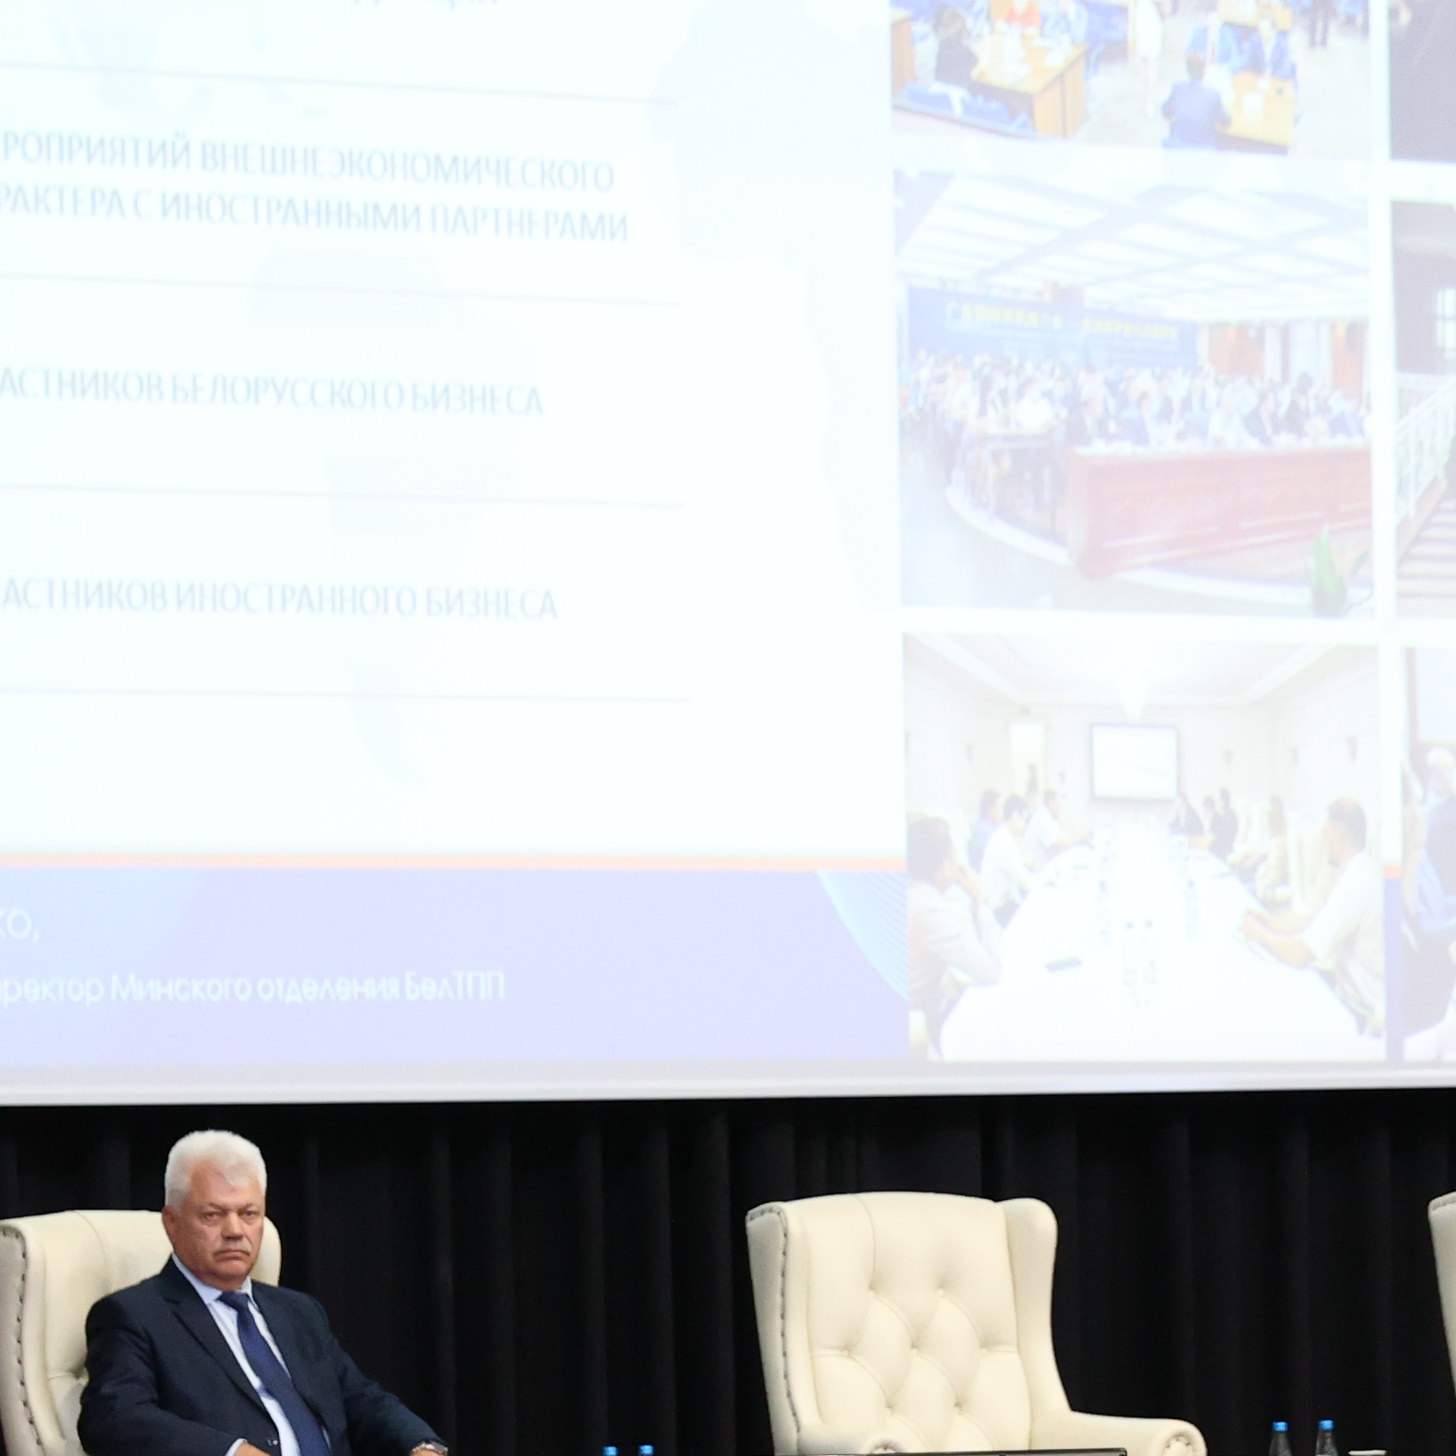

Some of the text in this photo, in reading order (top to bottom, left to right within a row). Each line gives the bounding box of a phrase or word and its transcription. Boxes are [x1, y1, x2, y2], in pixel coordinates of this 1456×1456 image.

[134, 186, 153, 220] С
[160, 191, 421, 233] ИНОСТРАННЫМИ
[430, 203, 630, 244] ПАРТНЕРАМИ
[171, 371, 406, 410] БЕЛОРУССКОГО
[411, 380, 545, 417] БИЗНЕСА
[175, 580, 417, 618] ИНОСТРАННОГО
[425, 586, 559, 620] БИЗНЕСА
[110, 971, 251, 1001] Минского
[257, 973, 401, 1002] отделения
[404, 970, 507, 1001] БелТПП
